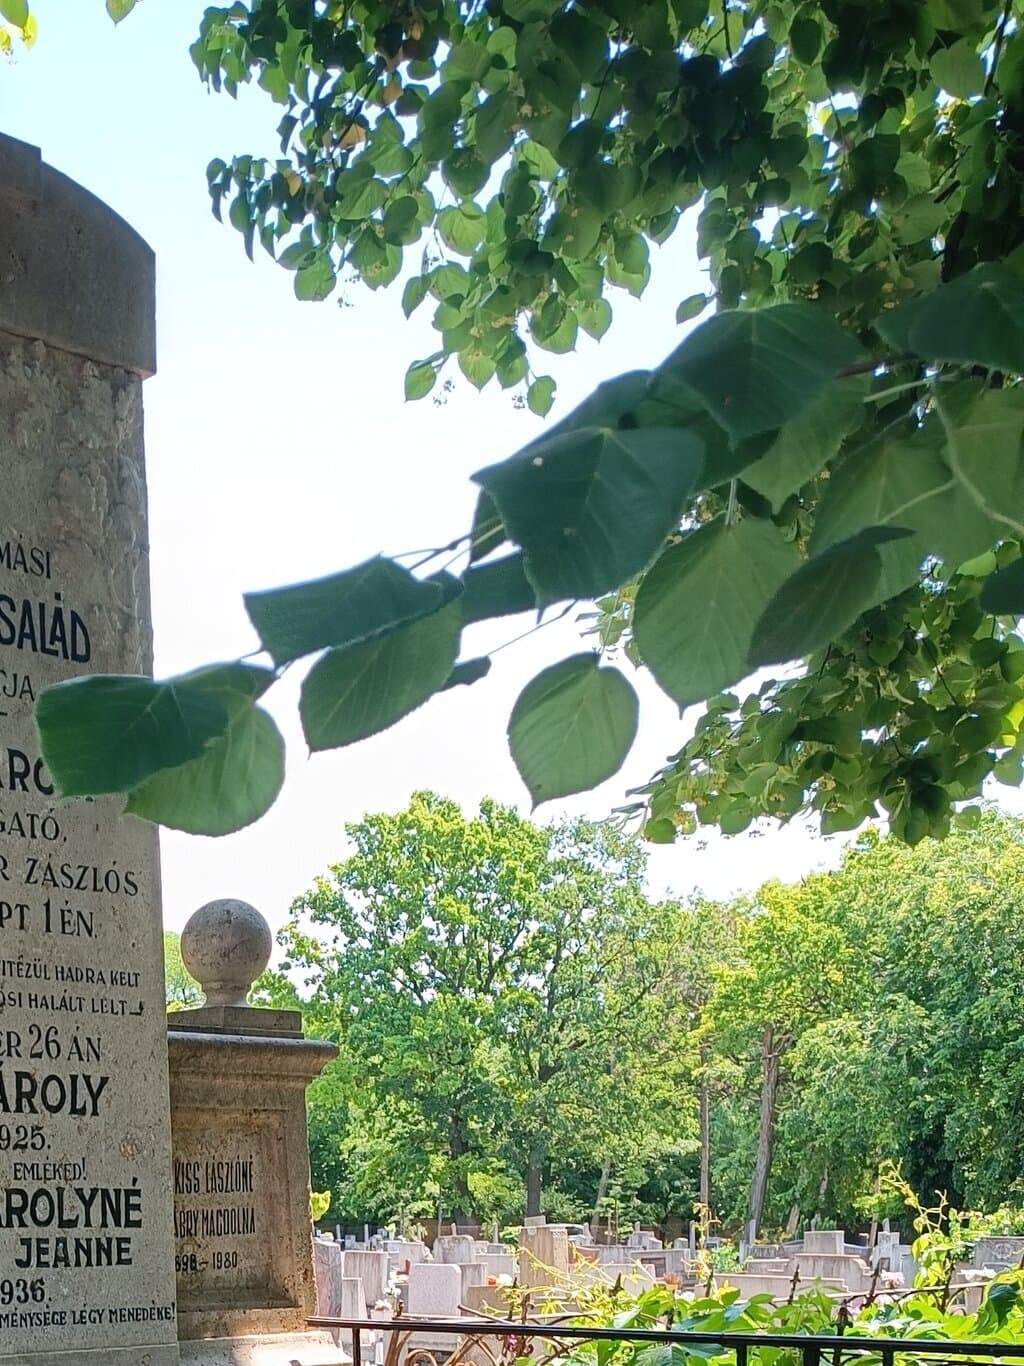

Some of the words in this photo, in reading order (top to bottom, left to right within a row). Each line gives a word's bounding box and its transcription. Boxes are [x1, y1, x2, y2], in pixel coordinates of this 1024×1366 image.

[24, 853, 139, 897] ZÁSZLÓS
[43, 898, 52, 934] 1
[55, 965, 106, 985] HADRA
[110, 970, 140, 988] KELT
[28, 989, 86, 1012] HALÁLT
[28, 1023, 61, 1060] 26
[67, 1026, 102, 1062] ÁN
[13, 1156, 87, 1181] EMLÉKED!
[14, 1236, 133, 1269] JEANNE
[72, 1303, 105, 1326] LÉGY
[108, 1300, 176, 1323] MENEDÉKE!
